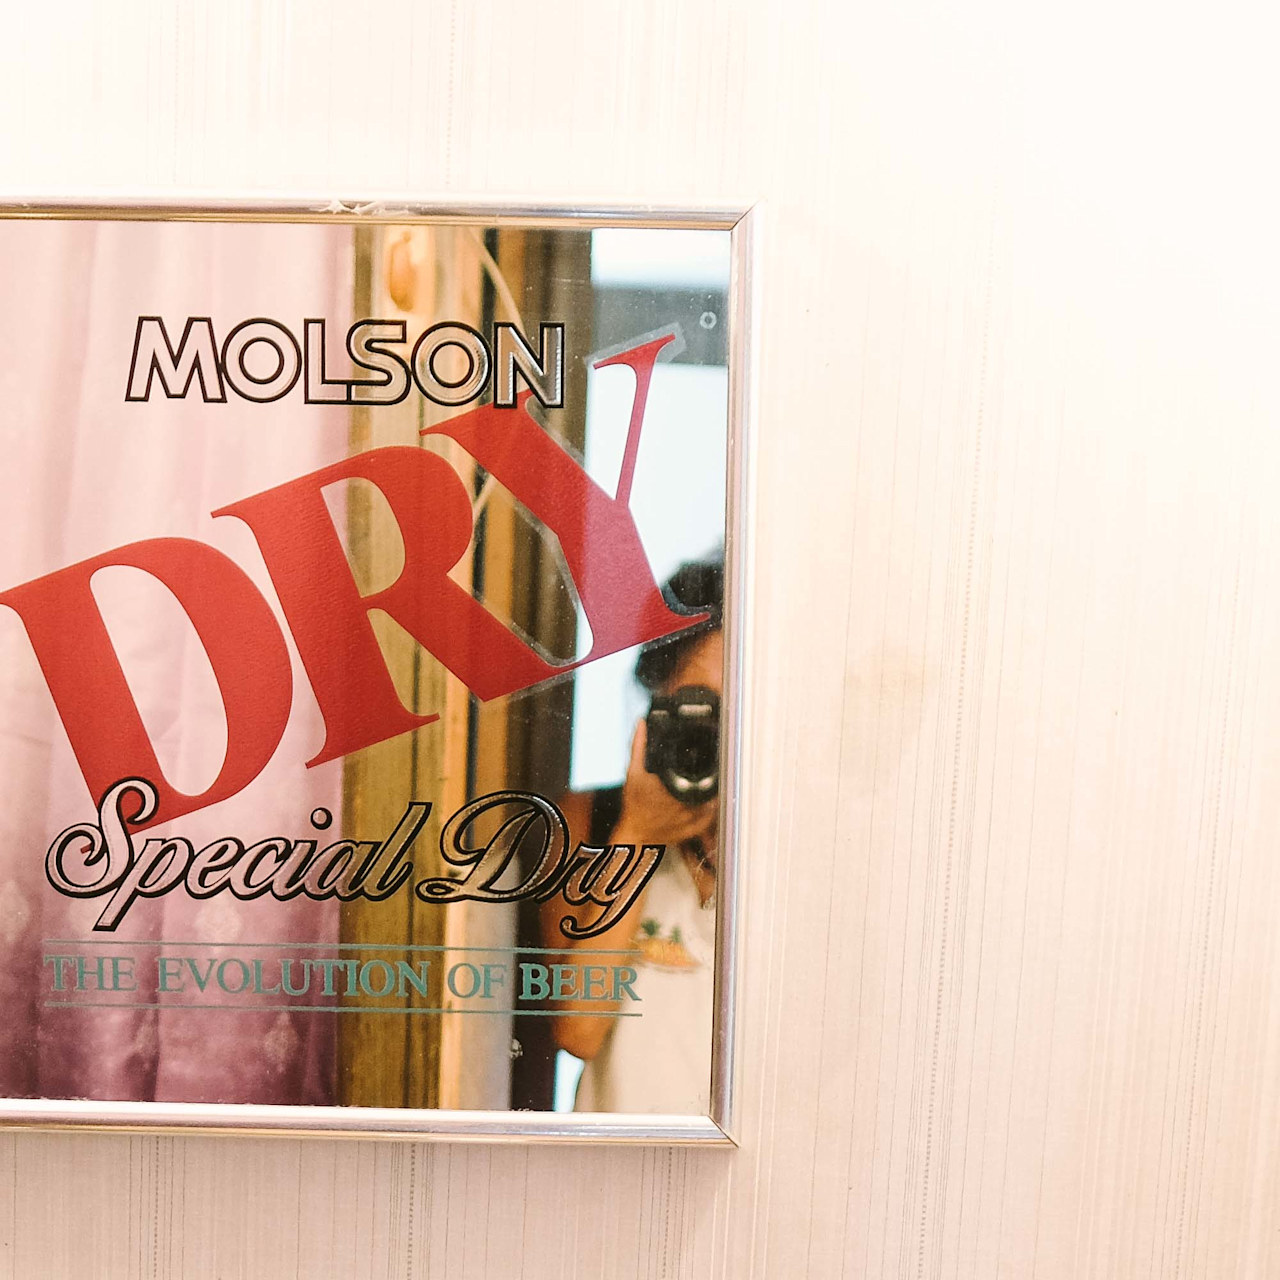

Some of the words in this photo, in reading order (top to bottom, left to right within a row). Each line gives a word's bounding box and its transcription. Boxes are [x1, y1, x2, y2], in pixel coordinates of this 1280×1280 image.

[124, 316, 565, 409] MOLSON
[44, 774, 431, 932] Special
[417, 789, 666, 939] Dry
[43, 953, 138, 993] THE
[157, 956, 432, 999] EVOLUTION
[446, 961, 508, 999] OF
[518, 962, 643, 1002] BEER
